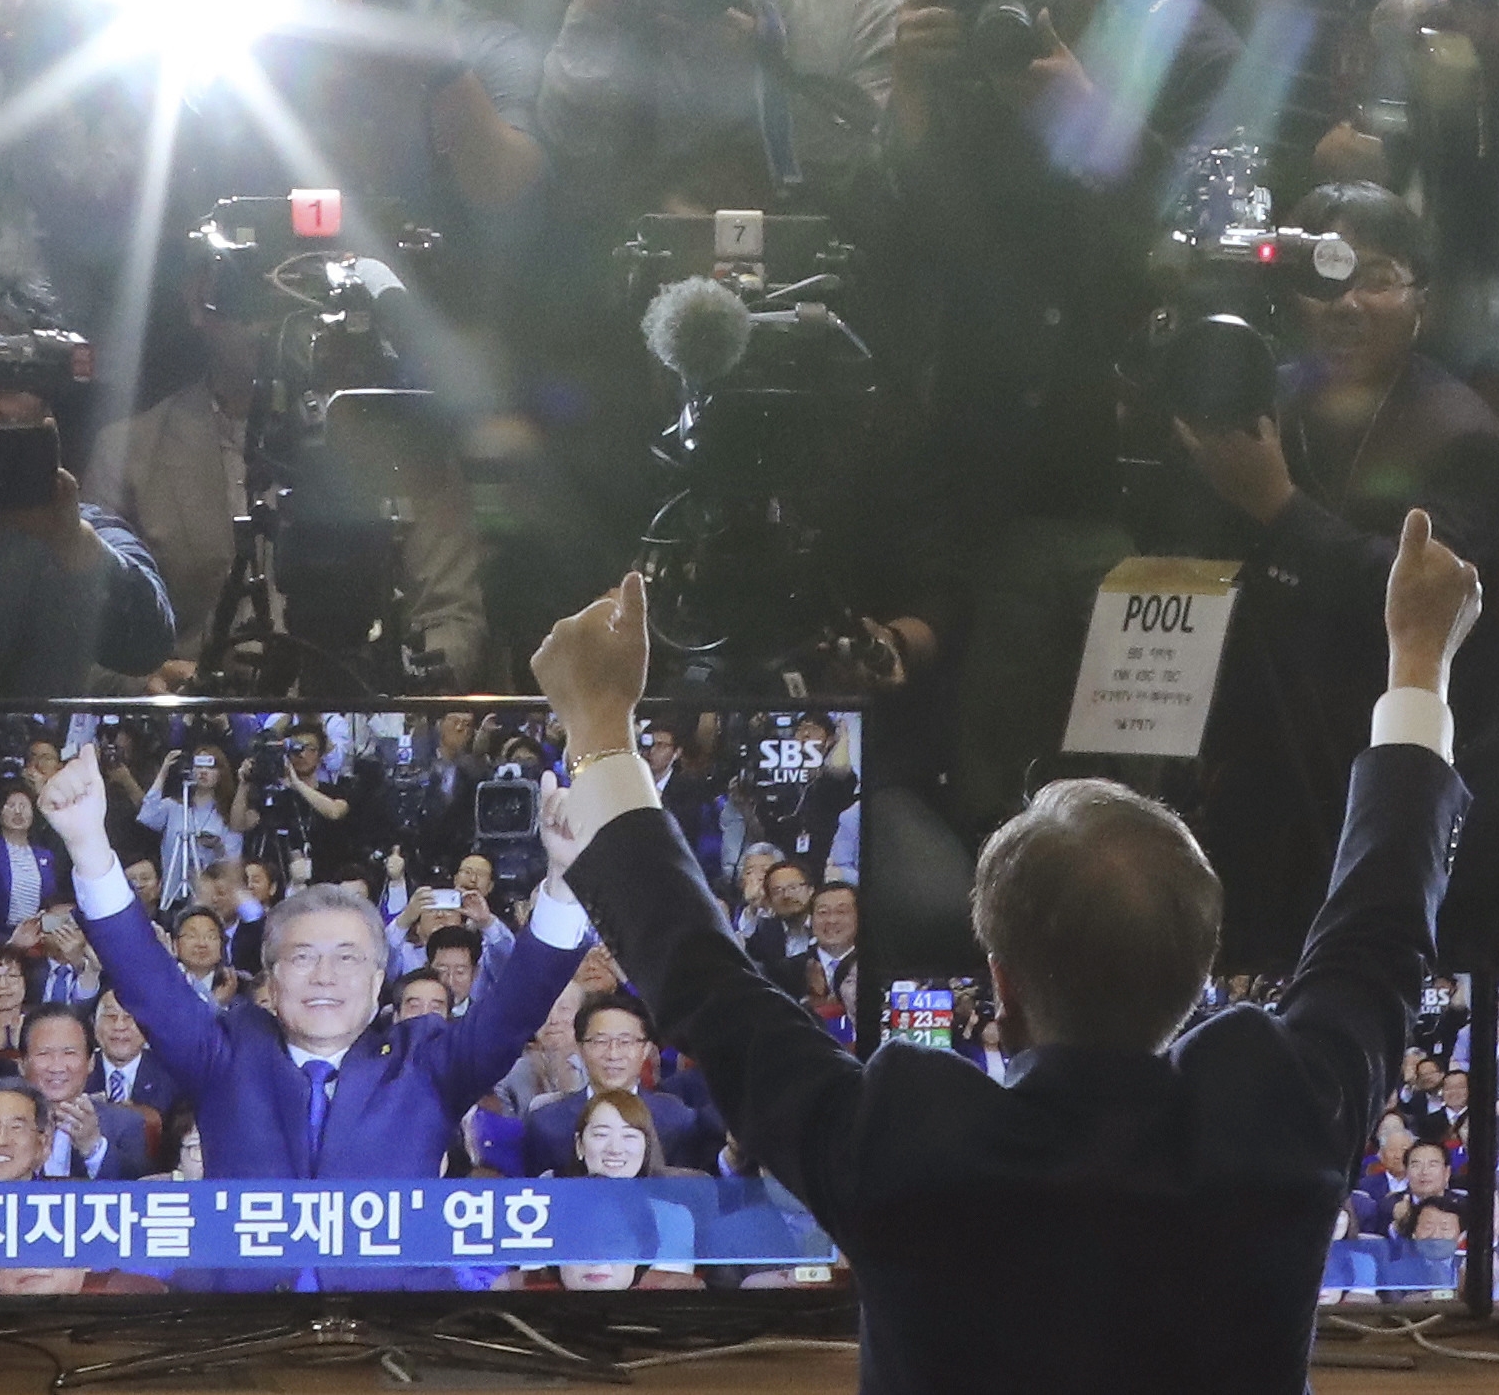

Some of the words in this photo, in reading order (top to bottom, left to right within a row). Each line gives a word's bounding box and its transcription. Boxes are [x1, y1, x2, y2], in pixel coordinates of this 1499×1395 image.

[733, 225, 747, 244] 7
[1121, 594, 1195, 634] POOL
[759, 739, 823, 769] SBS
[773, 769, 809, 783] LIVE
[1421, 988, 1450, 1006] BS
[214, 1188, 425, 1258] '문재인'
[442, 1187, 555, 1257] 연호
